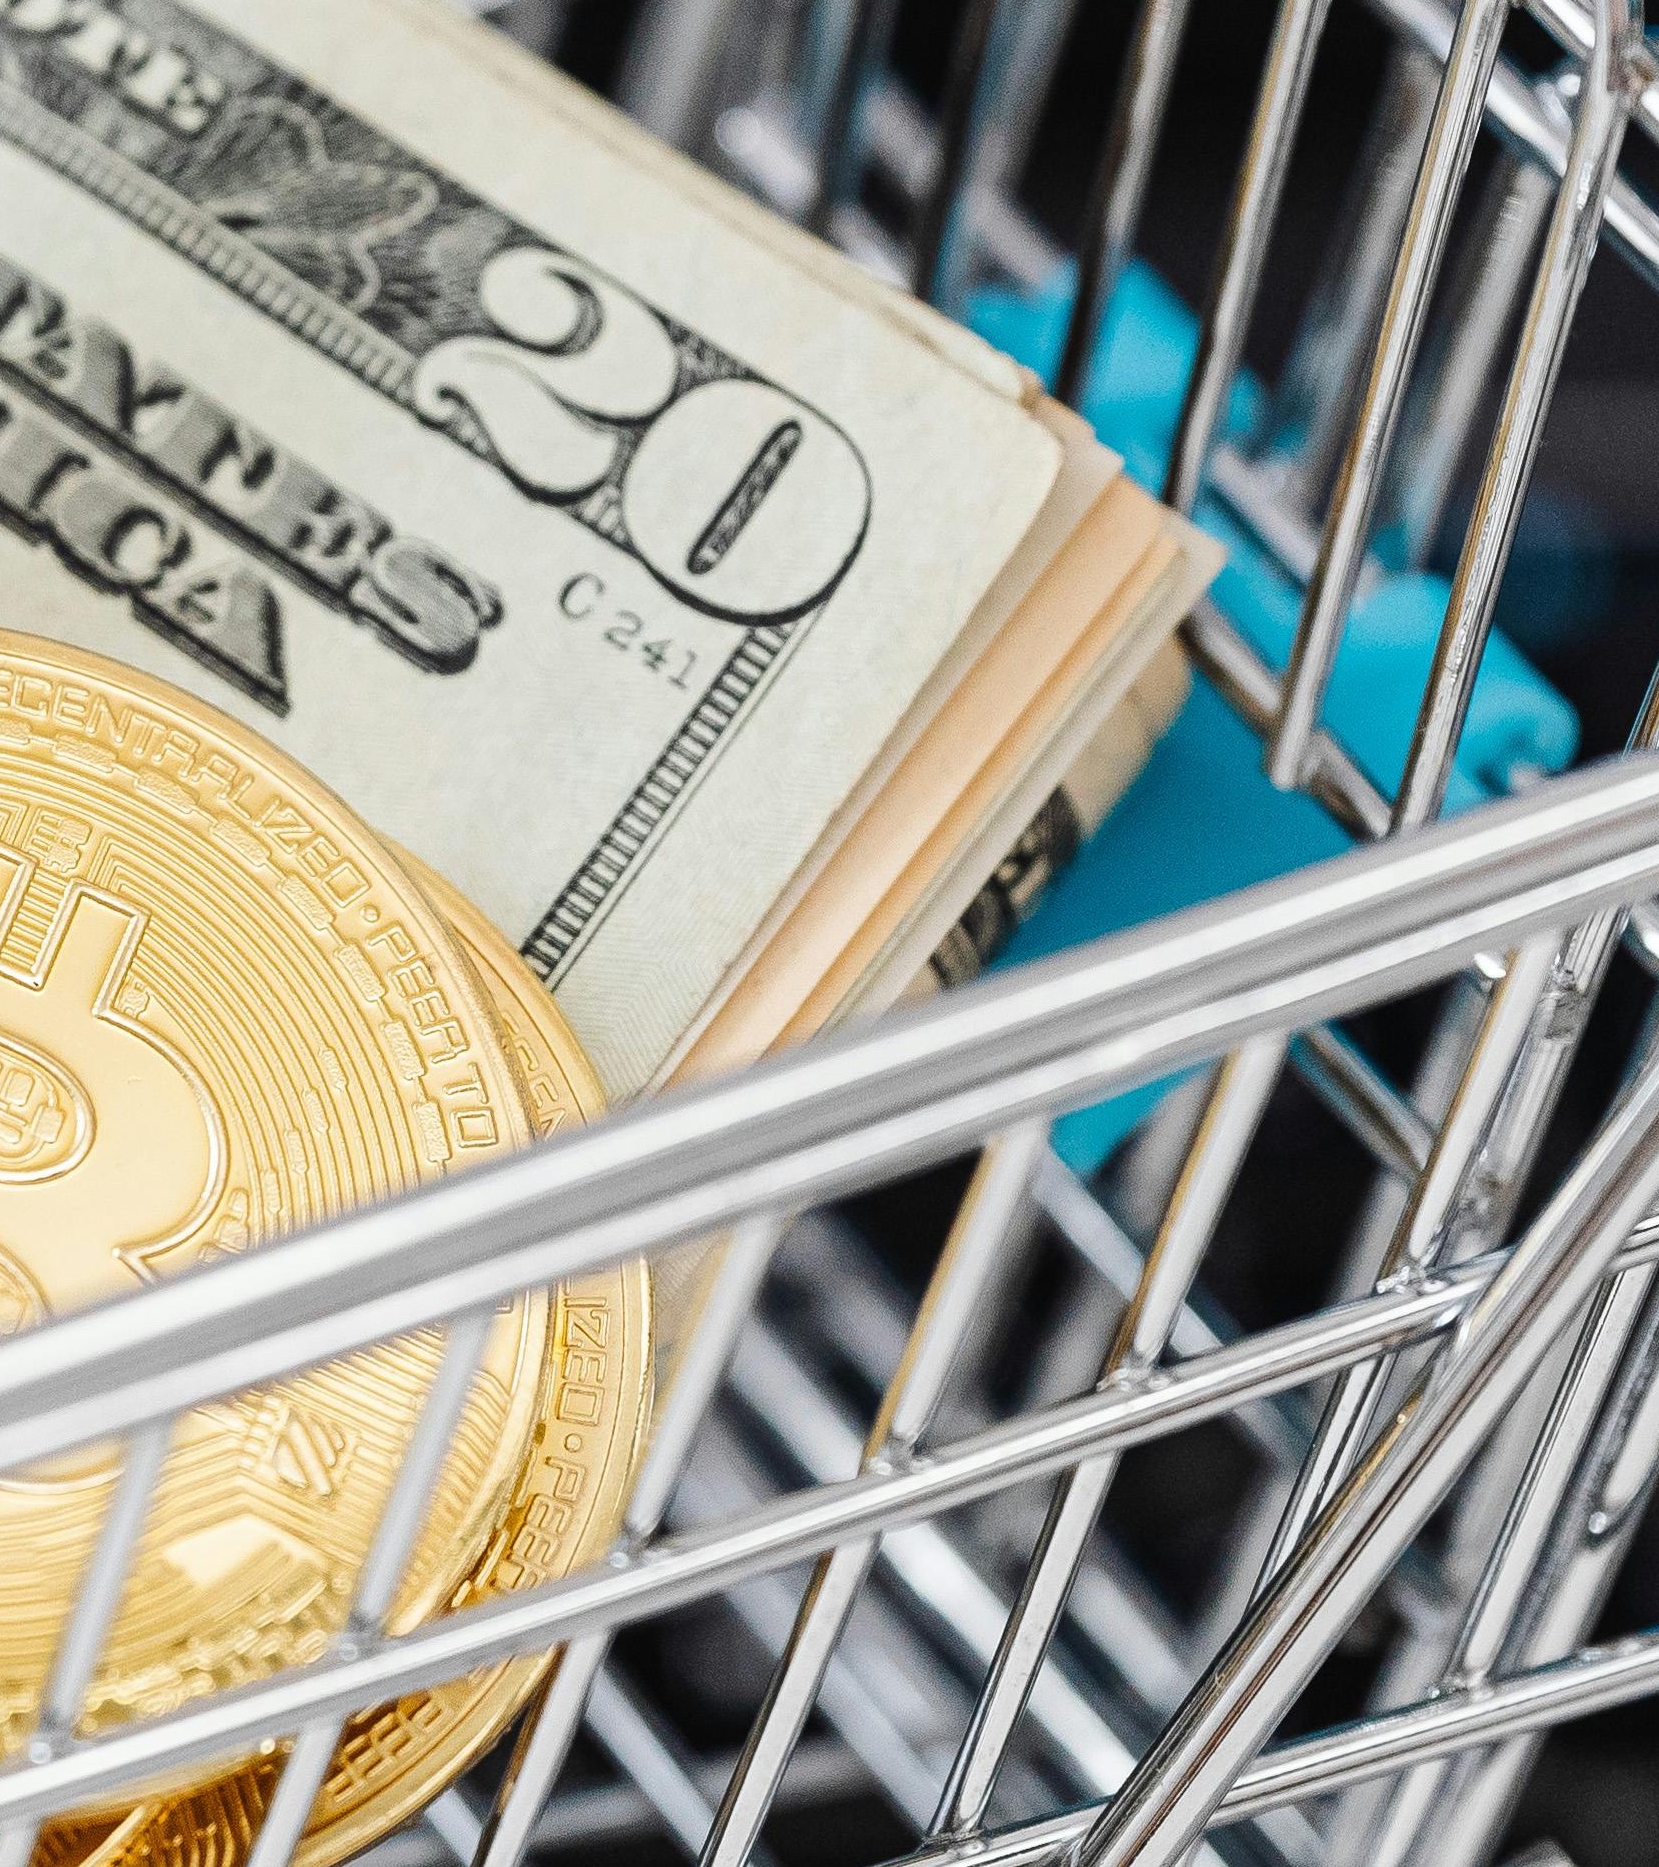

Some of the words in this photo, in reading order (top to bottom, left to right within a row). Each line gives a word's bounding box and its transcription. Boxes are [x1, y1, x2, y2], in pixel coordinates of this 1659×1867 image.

[413, 242, 871, 626] 20
[365, 924, 473, 1066] PEER
[441, 1058, 501, 1152] TO
